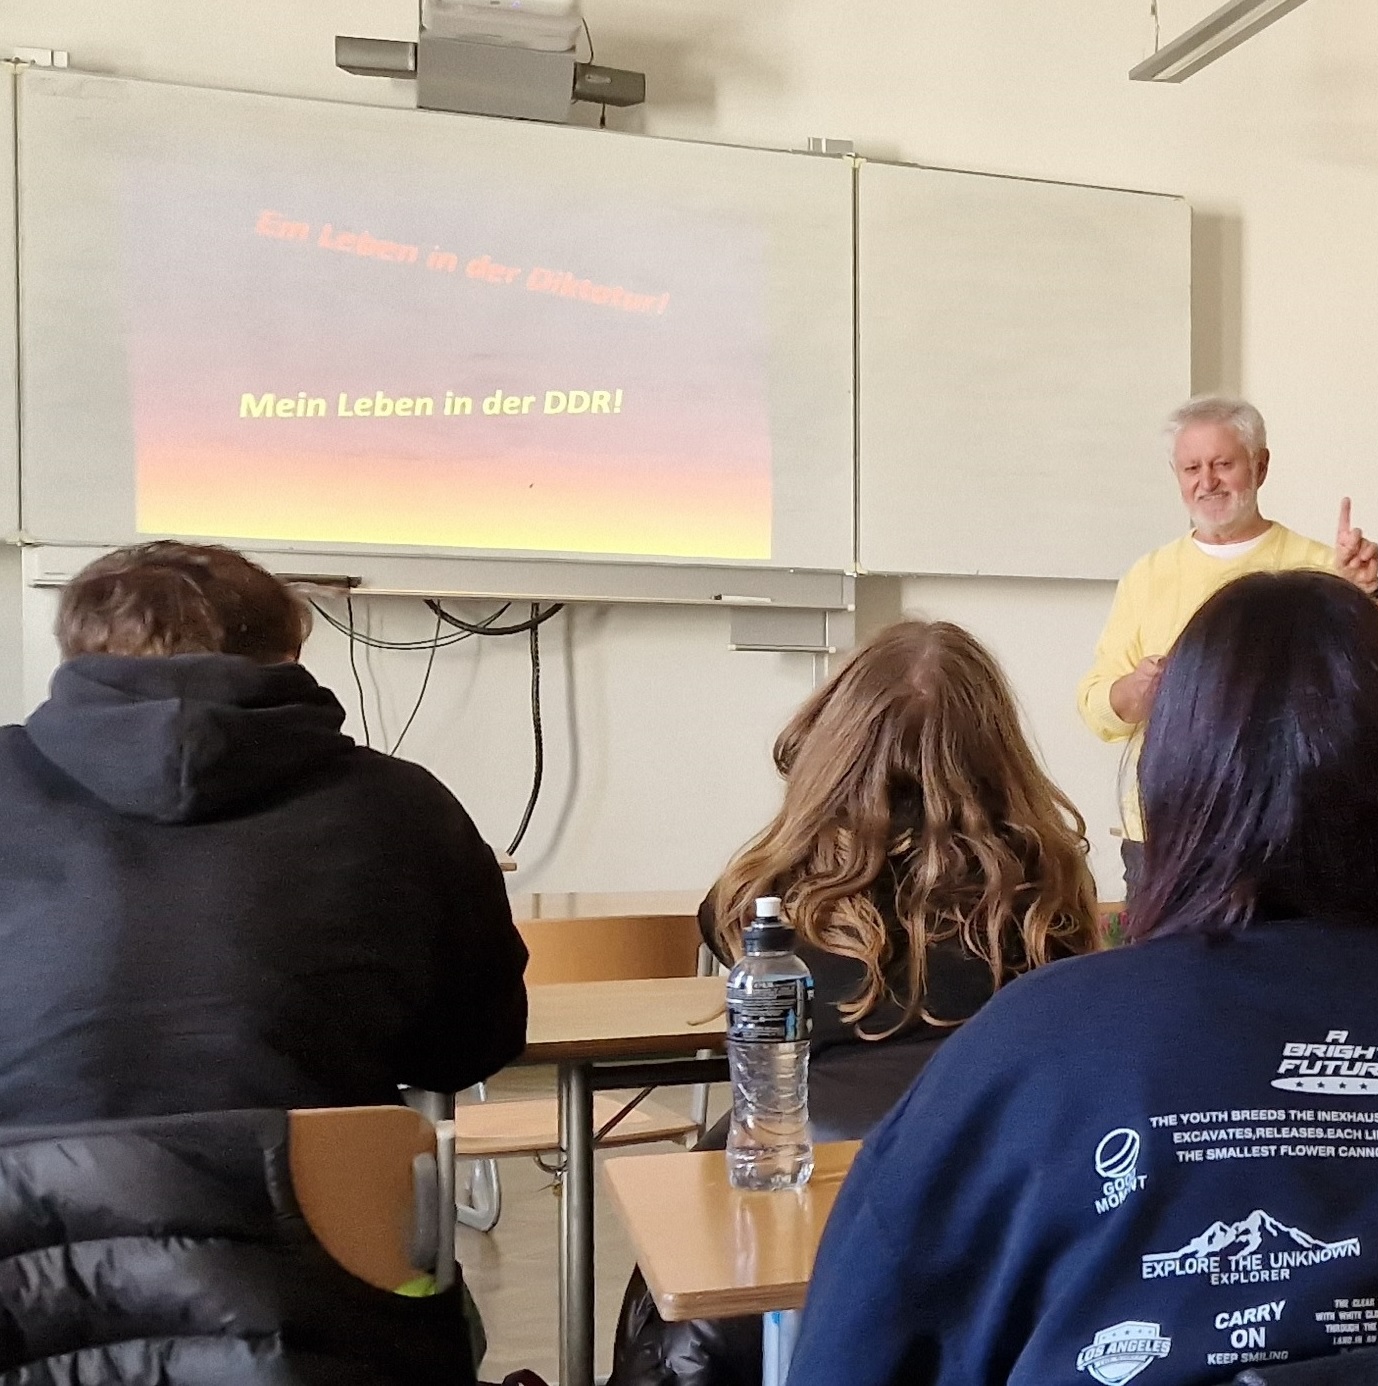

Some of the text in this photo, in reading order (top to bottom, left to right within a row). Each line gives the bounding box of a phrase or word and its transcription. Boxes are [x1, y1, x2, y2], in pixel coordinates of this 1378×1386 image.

[256, 209, 670, 314] Ein Leben in der Diktatur!
[239, 389, 623, 418] Mein Leben in der DDR!
[1325, 1030, 1349, 1043] A
[1150, 1114, 1178, 1128] THE
[1180, 1110, 1229, 1125] YOUTH
[1231, 1109, 1286, 1121] BREEDS
[1288, 1110, 1315, 1121] THE
[1176, 1150, 1203, 1162] THE
[1206, 1145, 1278, 1160] SMALLEST
[1280, 1145, 1335, 1157] FLOWER
[1142, 1242, 1360, 1279] EXPLORE THE UNKNOWN
[1210, 1268, 1290, 1285] EXPLORER
[1215, 1300, 1286, 1329] CARRY
[1230, 1327, 1265, 1349] ON
[1077, 1344, 1106, 1368] LOS
[1105, 1339, 1172, 1355] ANGELES
[1207, 1350, 1289, 1365] KEEP SMILING
